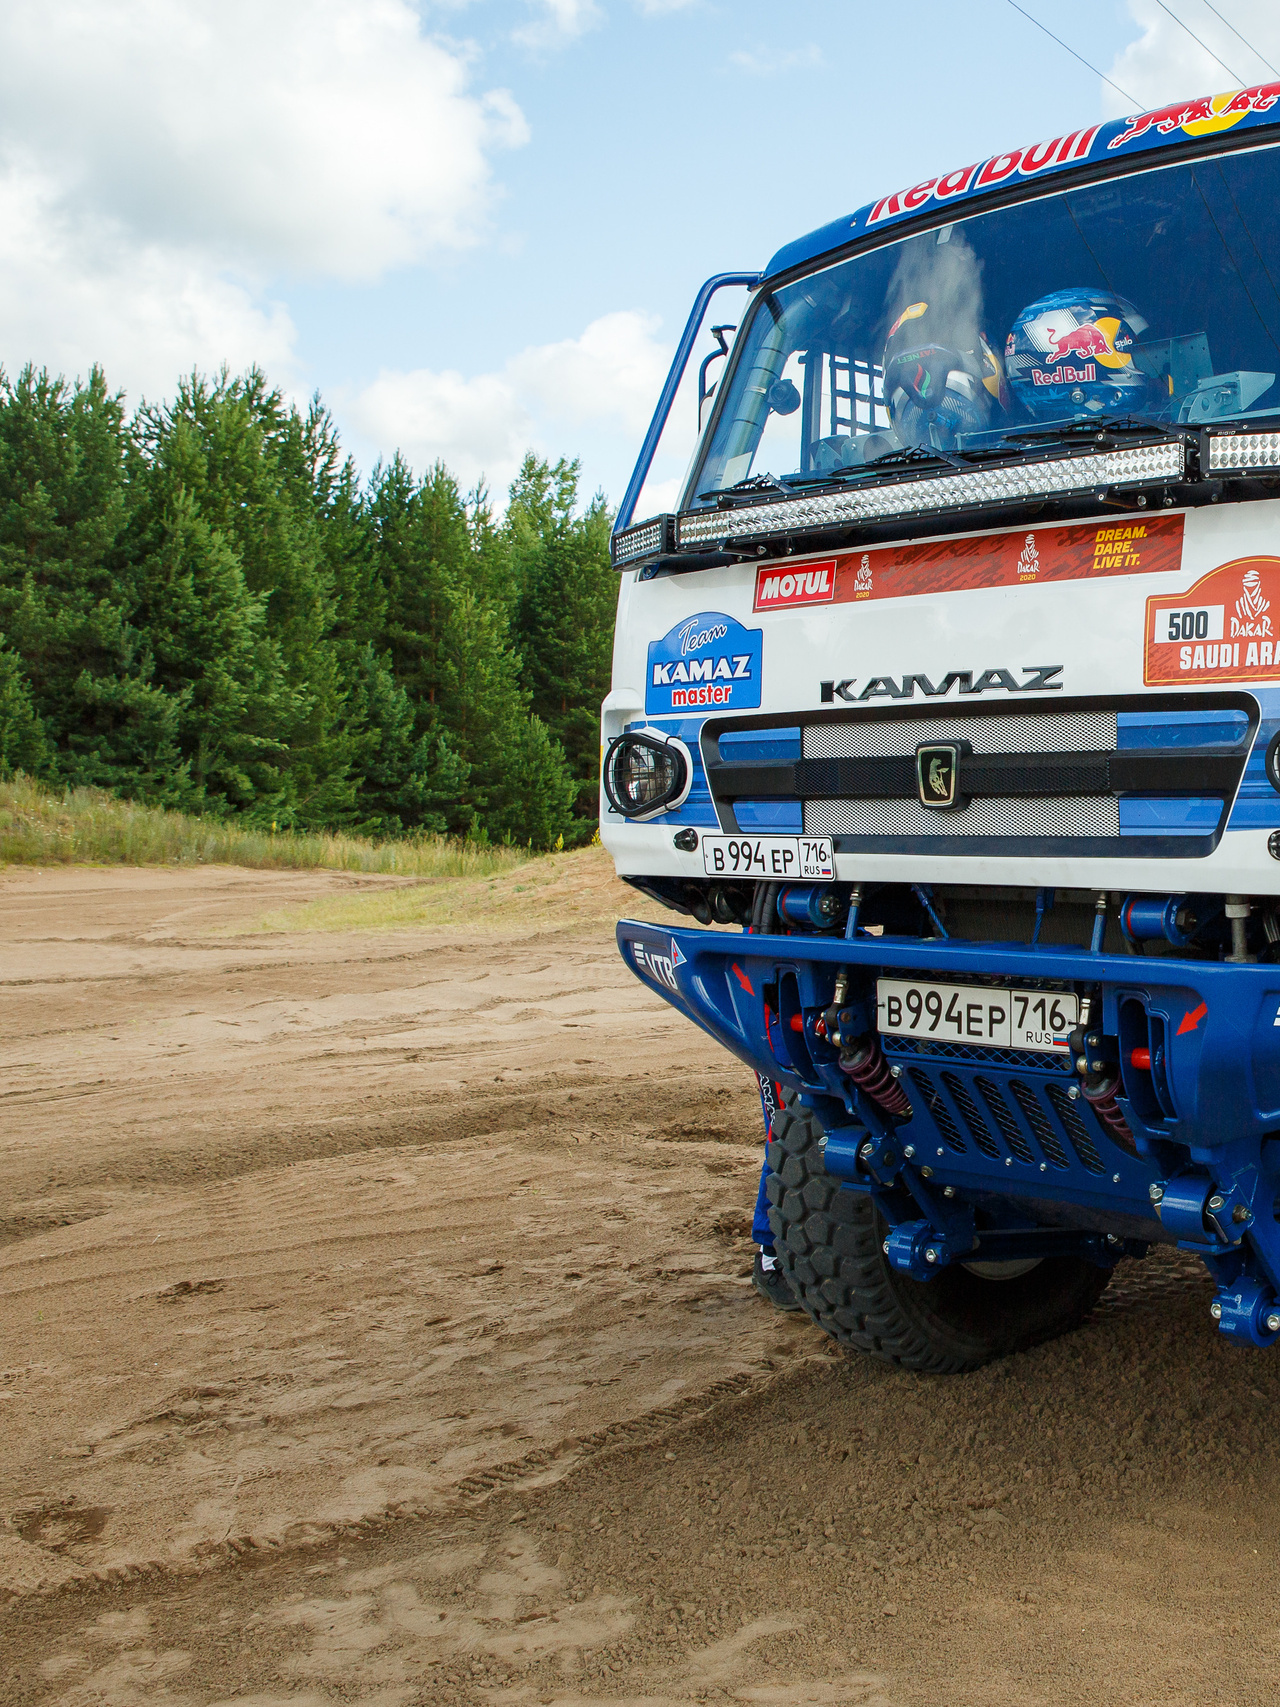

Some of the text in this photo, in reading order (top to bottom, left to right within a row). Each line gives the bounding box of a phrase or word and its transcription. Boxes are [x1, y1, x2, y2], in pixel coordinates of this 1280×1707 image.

[1032, 363, 1096, 386] Red Bull
[1095, 525, 1148, 541] DREAM.
[1094, 541, 1134, 556] DARE.
[1016, 560, 1040, 573] DAKAR
[1093, 554, 1140, 570] LIVE IT.
[761, 570, 830, 600] MOTUL
[854, 580, 873, 592] DAKAR
[1019, 573, 1036, 581] 2020
[855, 590, 870, 598] 2020
[1168, 610, 1208, 640] 500
[1230, 616, 1273, 638] DAKAR
[679, 619, 727, 656] Team
[1179, 643, 1239, 670] SAUDI
[653, 655, 750, 686] KAMAZ
[819, 665, 1064, 703] KAMAZ
[671, 685, 732, 707] master
[802, 843, 827, 863] 716
[804, 865, 821, 875] RUS
[644, 952, 678, 990] VTB
[1014, 996, 1066, 1032] 716
[1026, 1031, 1052, 1045] RUS
